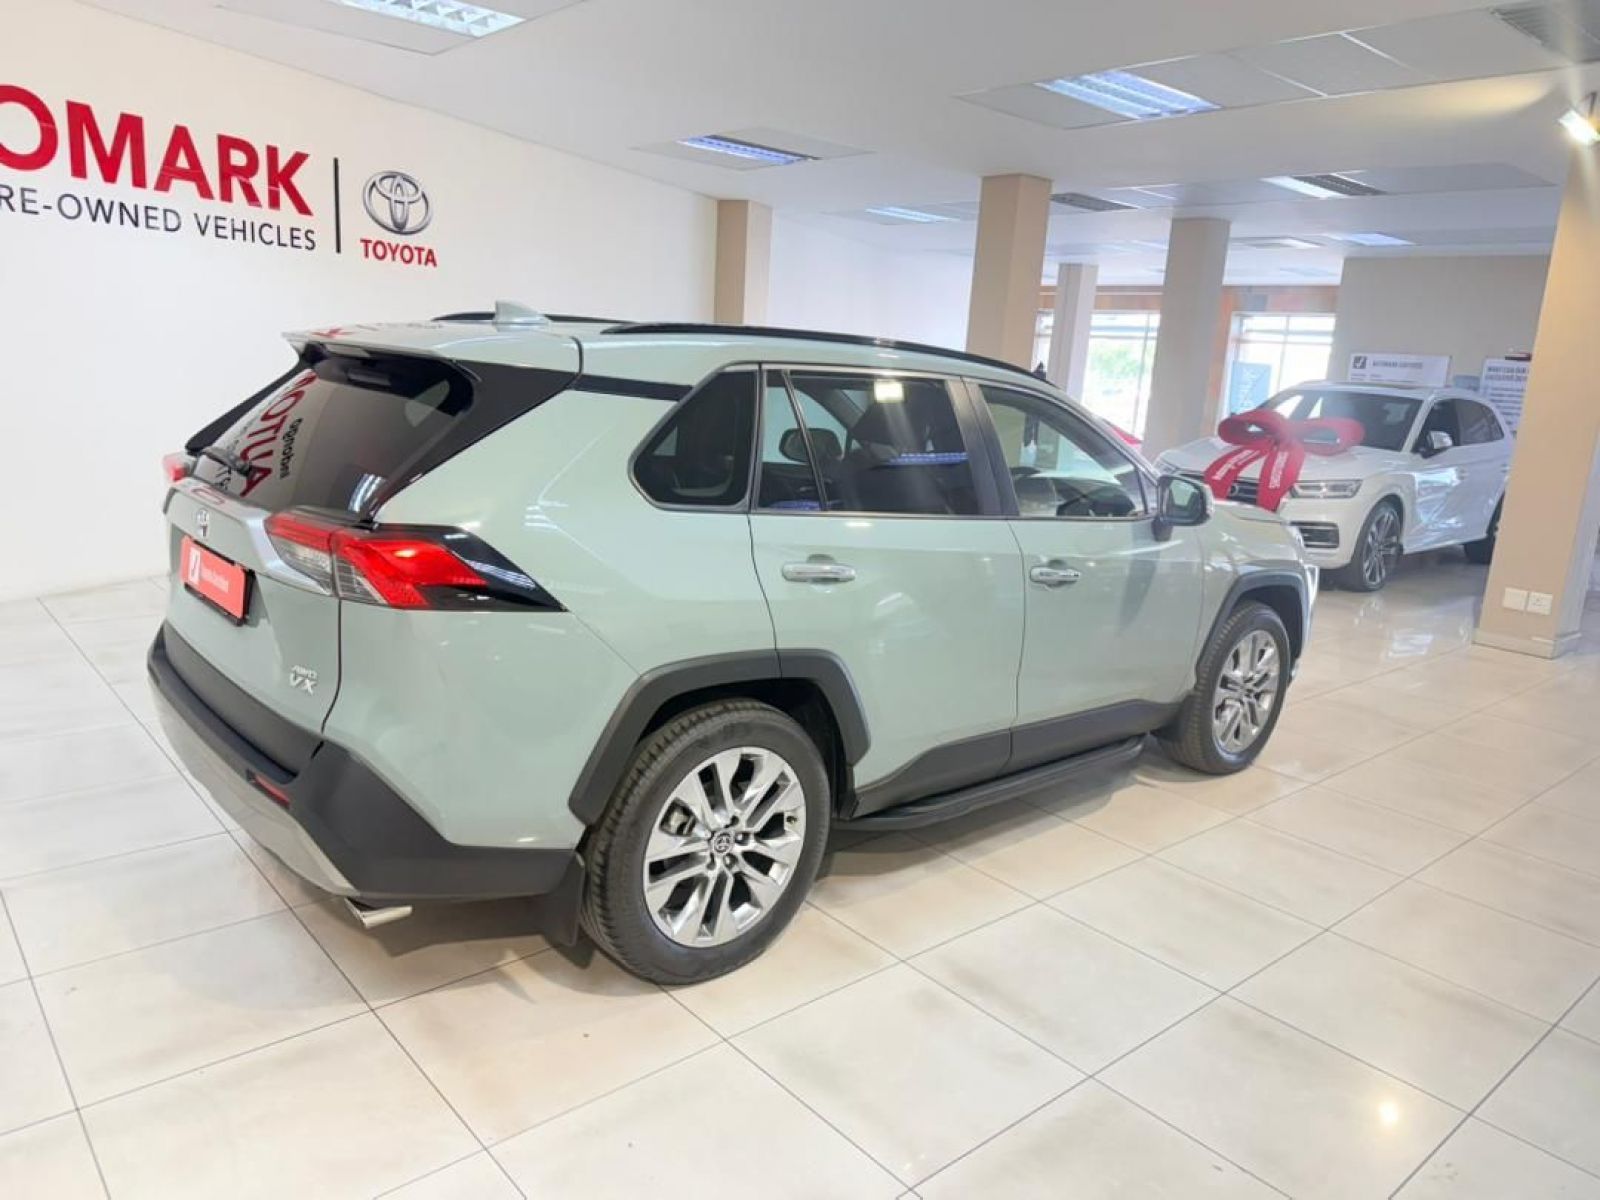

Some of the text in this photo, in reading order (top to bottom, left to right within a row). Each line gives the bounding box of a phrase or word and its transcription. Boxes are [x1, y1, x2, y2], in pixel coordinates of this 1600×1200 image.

[194, 212, 316, 251] VEHICLES
[360, 238, 438, 267] TOYOTA
[289, 672, 317, 696] VX
